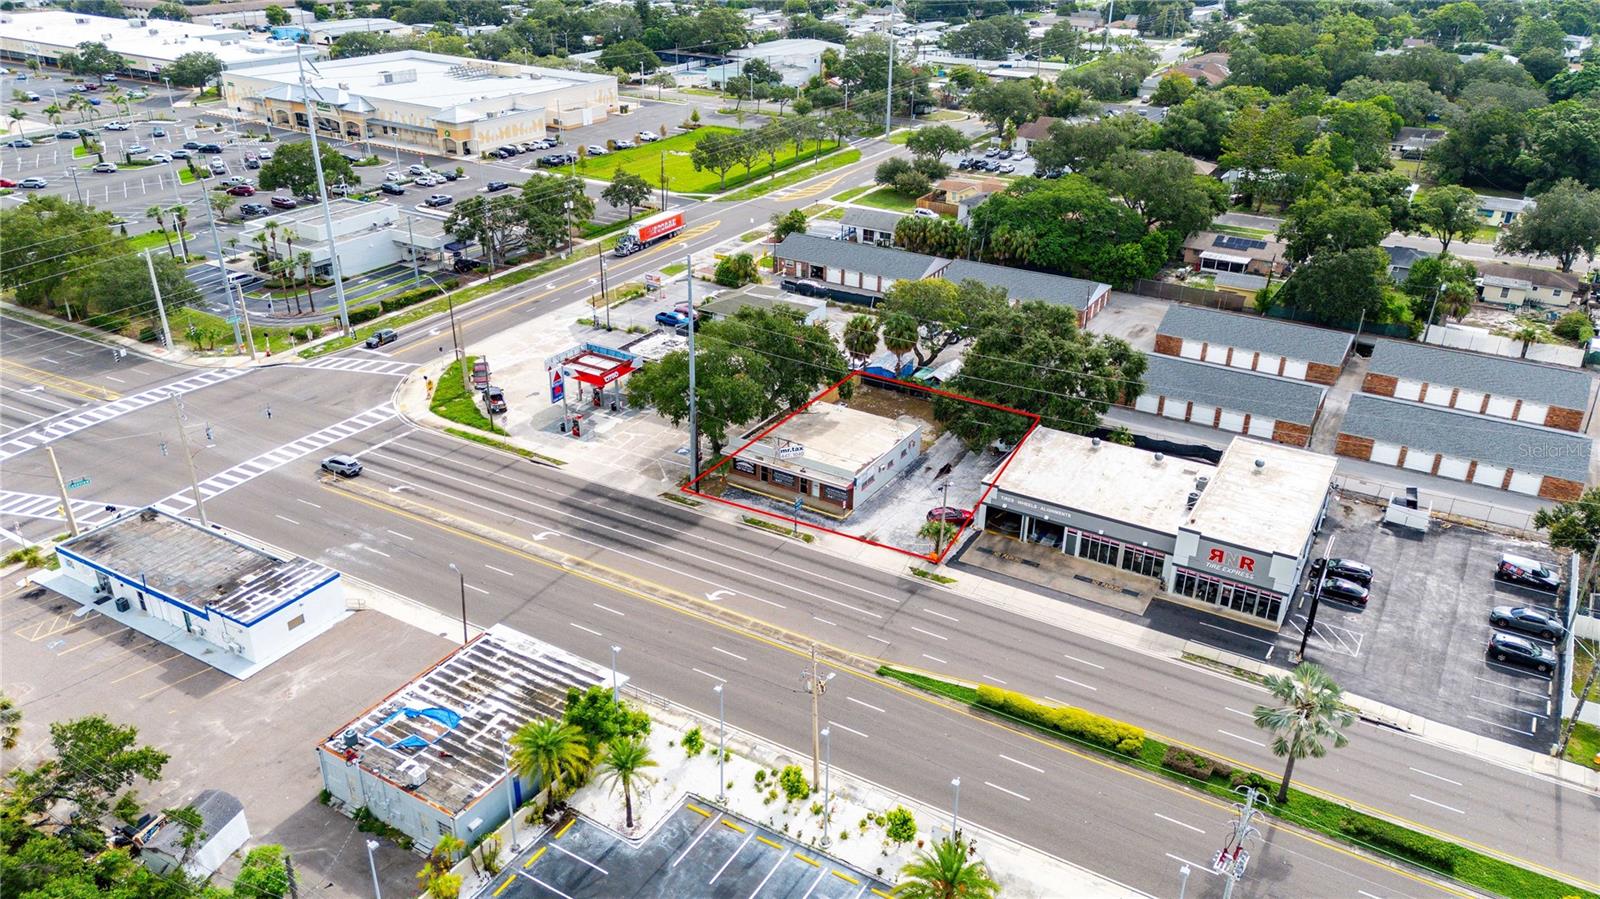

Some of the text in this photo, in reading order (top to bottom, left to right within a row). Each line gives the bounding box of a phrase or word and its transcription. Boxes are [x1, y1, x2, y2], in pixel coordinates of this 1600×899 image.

[1000, 495, 1014, 503] TIRES
[1017, 501, 1037, 509] WHEELS
[1206, 562, 1254, 580] TIRE EXPRESS
